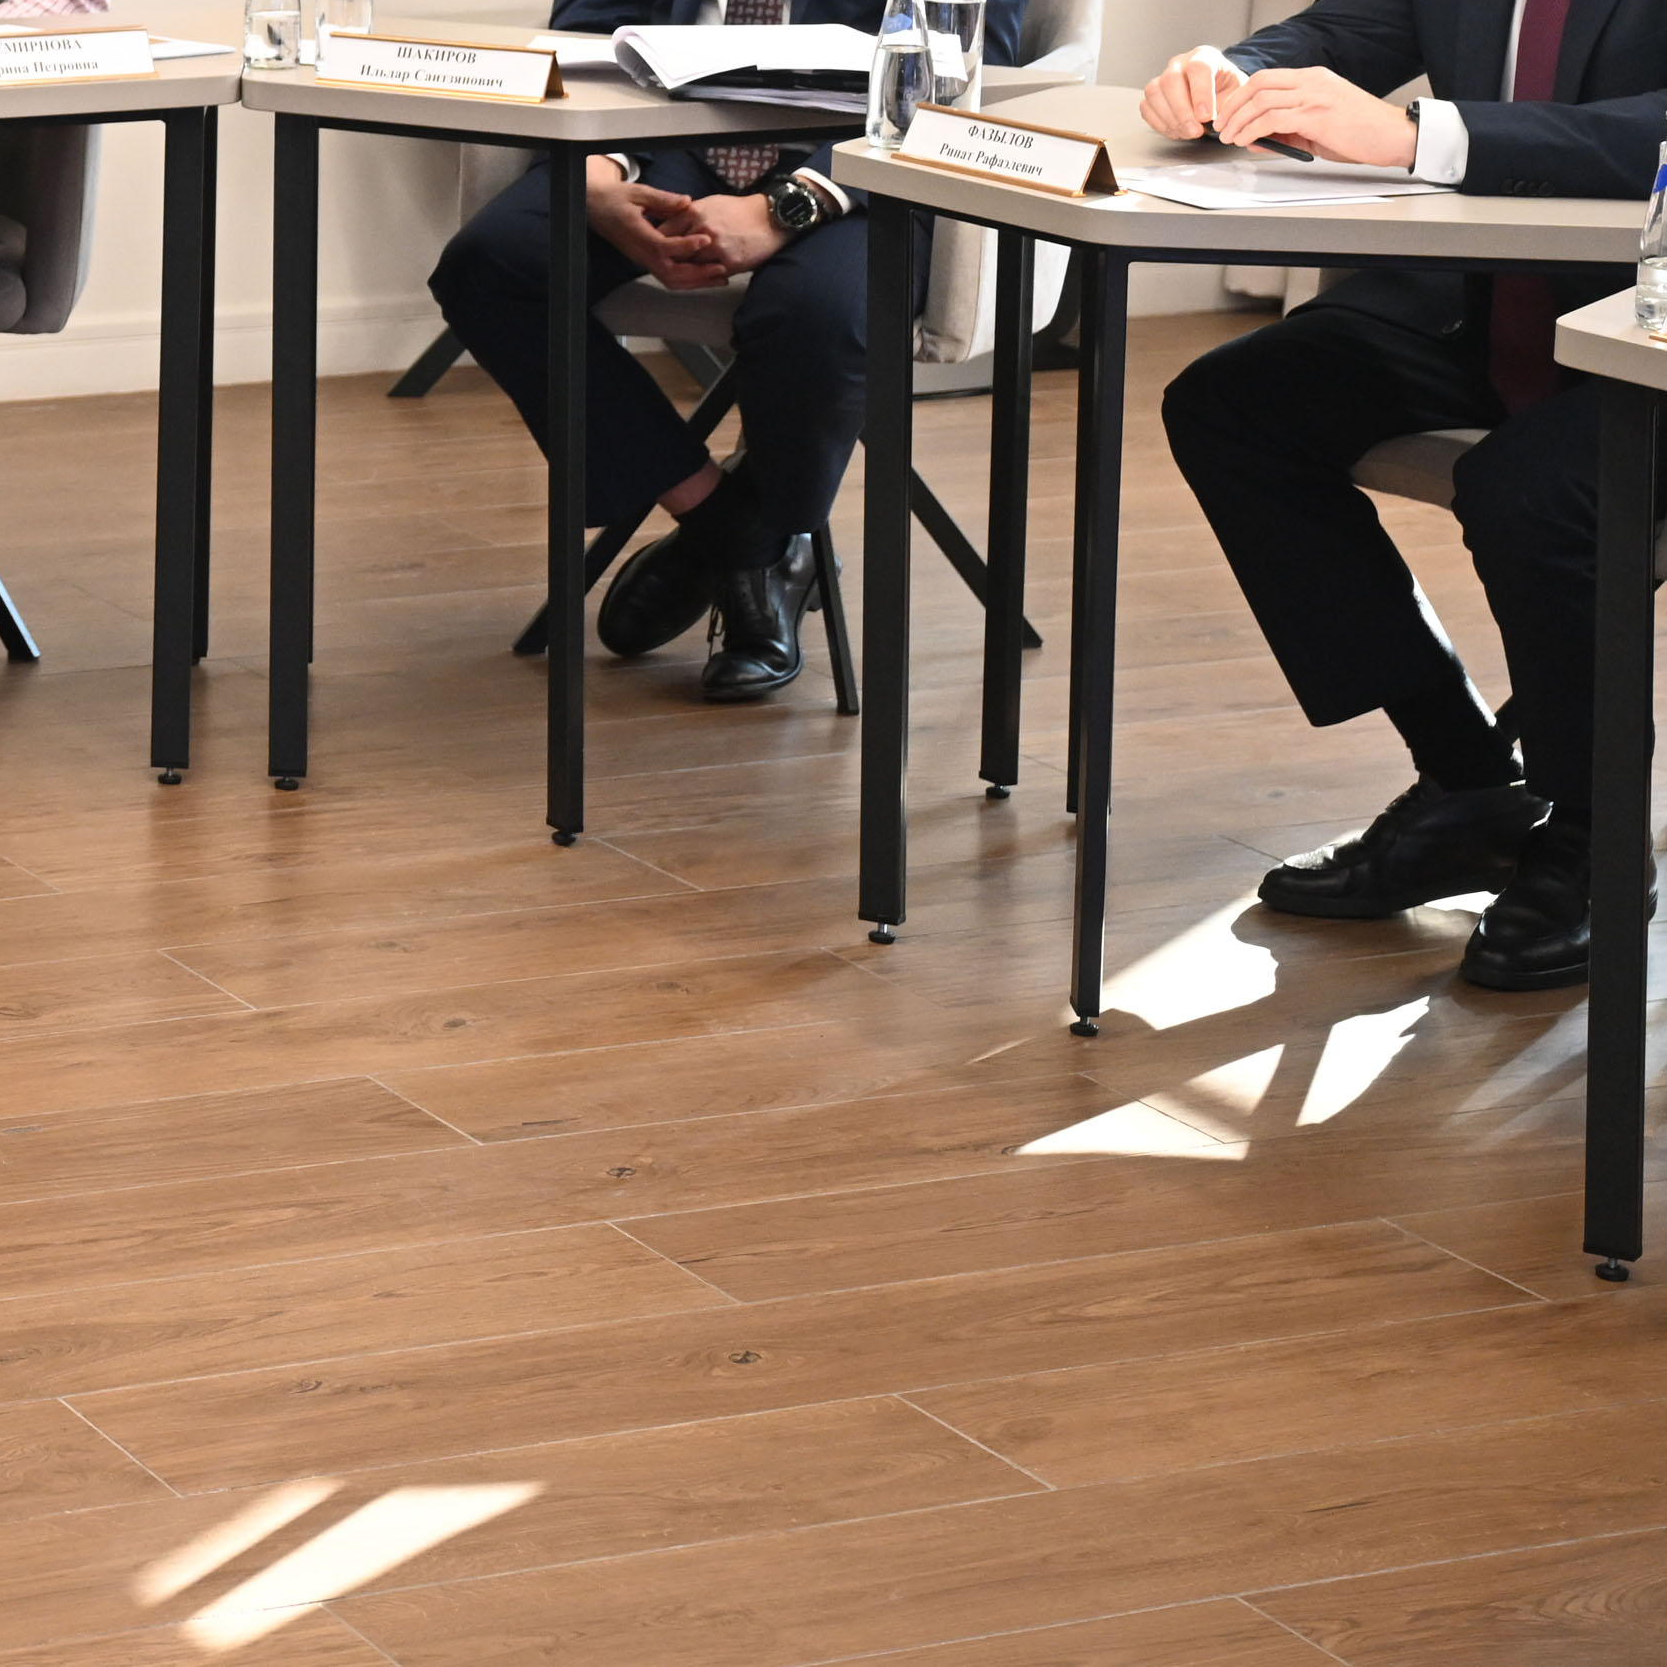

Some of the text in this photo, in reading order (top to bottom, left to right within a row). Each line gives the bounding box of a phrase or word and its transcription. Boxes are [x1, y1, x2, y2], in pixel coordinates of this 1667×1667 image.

[396, 46, 477, 64] ШАКИРОВ
[33, 61, 98, 74] Петровна
[360, 64, 410, 82] Ильдар
[968, 125, 1035, 150] ФАЗЫЛОВ
[939, 142, 1043, 176] Ринат Рафаэлевич
